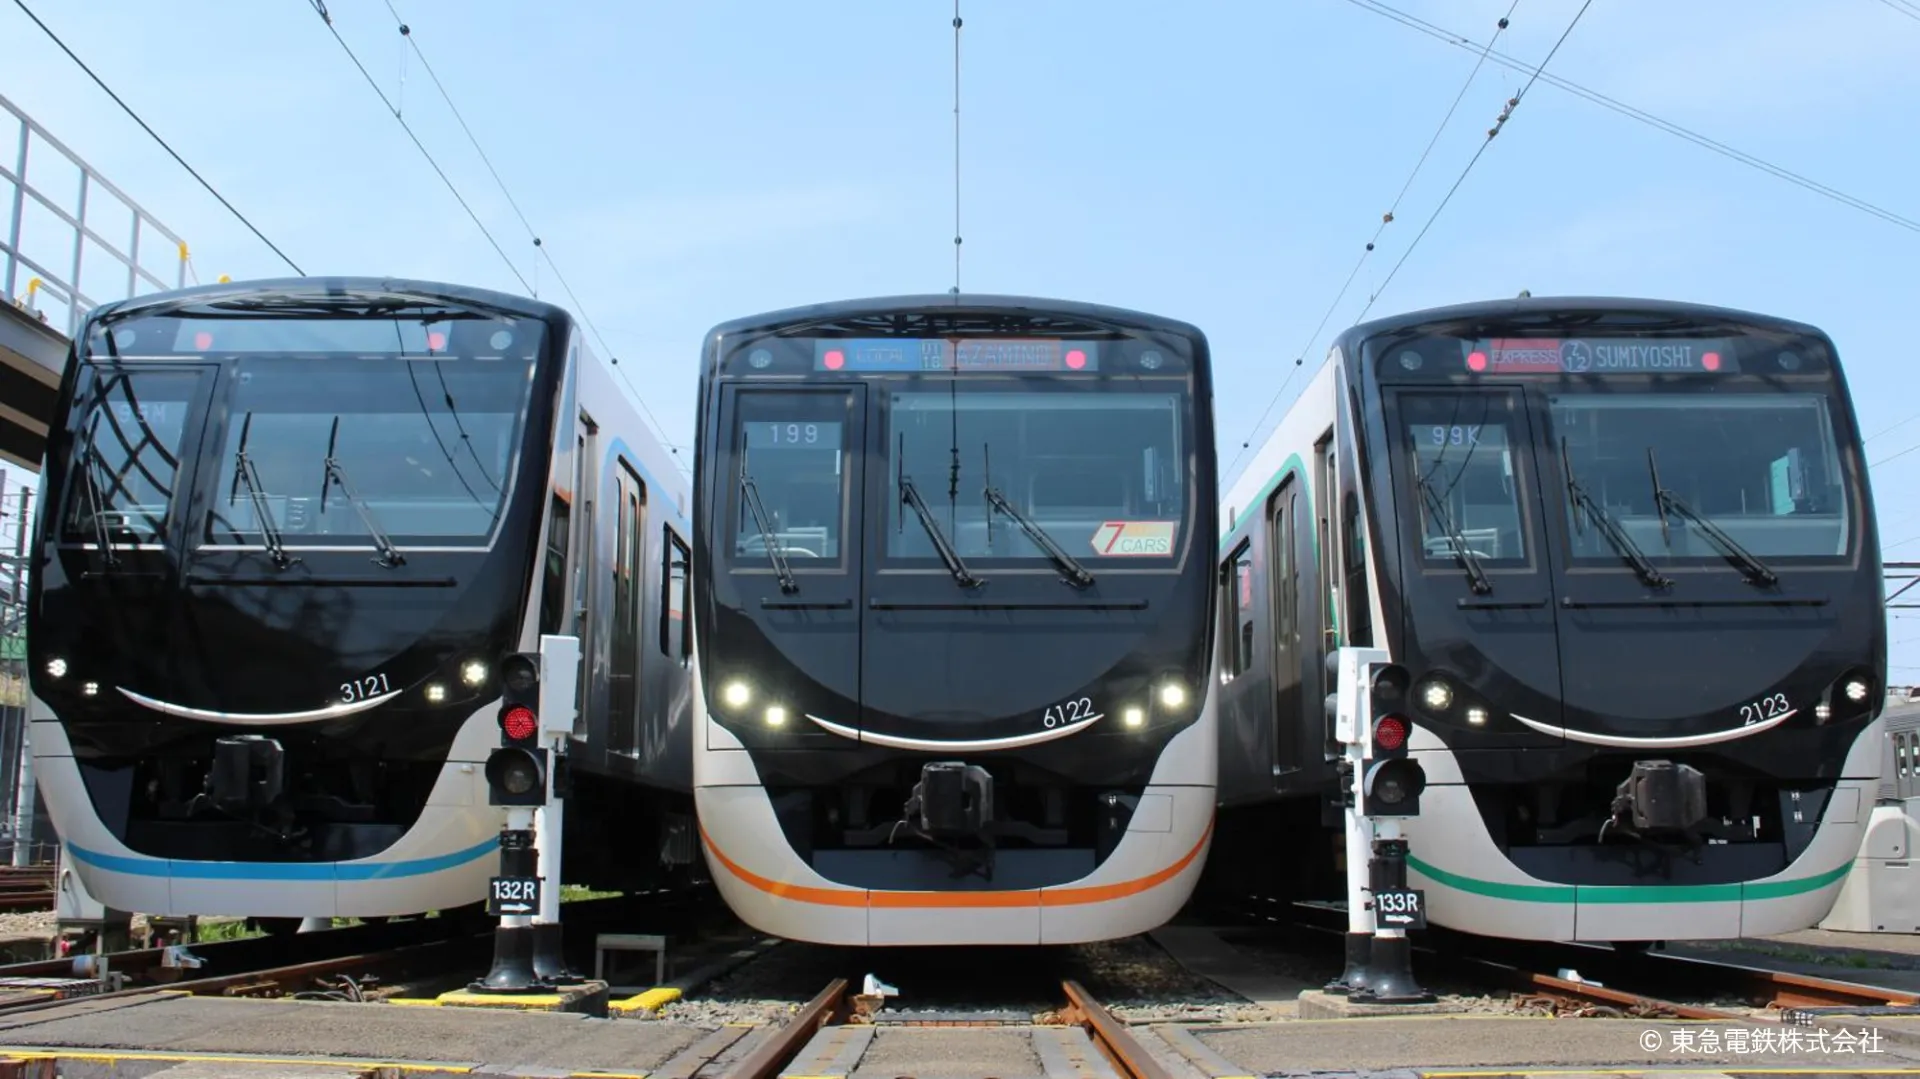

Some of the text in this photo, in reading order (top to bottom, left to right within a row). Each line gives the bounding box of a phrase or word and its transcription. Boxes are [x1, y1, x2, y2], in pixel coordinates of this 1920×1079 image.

[956, 344, 1051, 365] AZAMINO
[1491, 349, 1559, 364] EXPRESS
[1596, 345, 1693, 368] SUMIYOSHI
[770, 424, 818, 443] 199
[1433, 425, 1480, 445] 99K
[1105, 522, 1168, 553] 7 CARS
[340, 673, 389, 703] 3121
[1043, 697, 1095, 728] 6122
[1740, 693, 1790, 726] 2123
[492, 881, 535, 900] 132R
[1376, 893, 1419, 912] 133R
